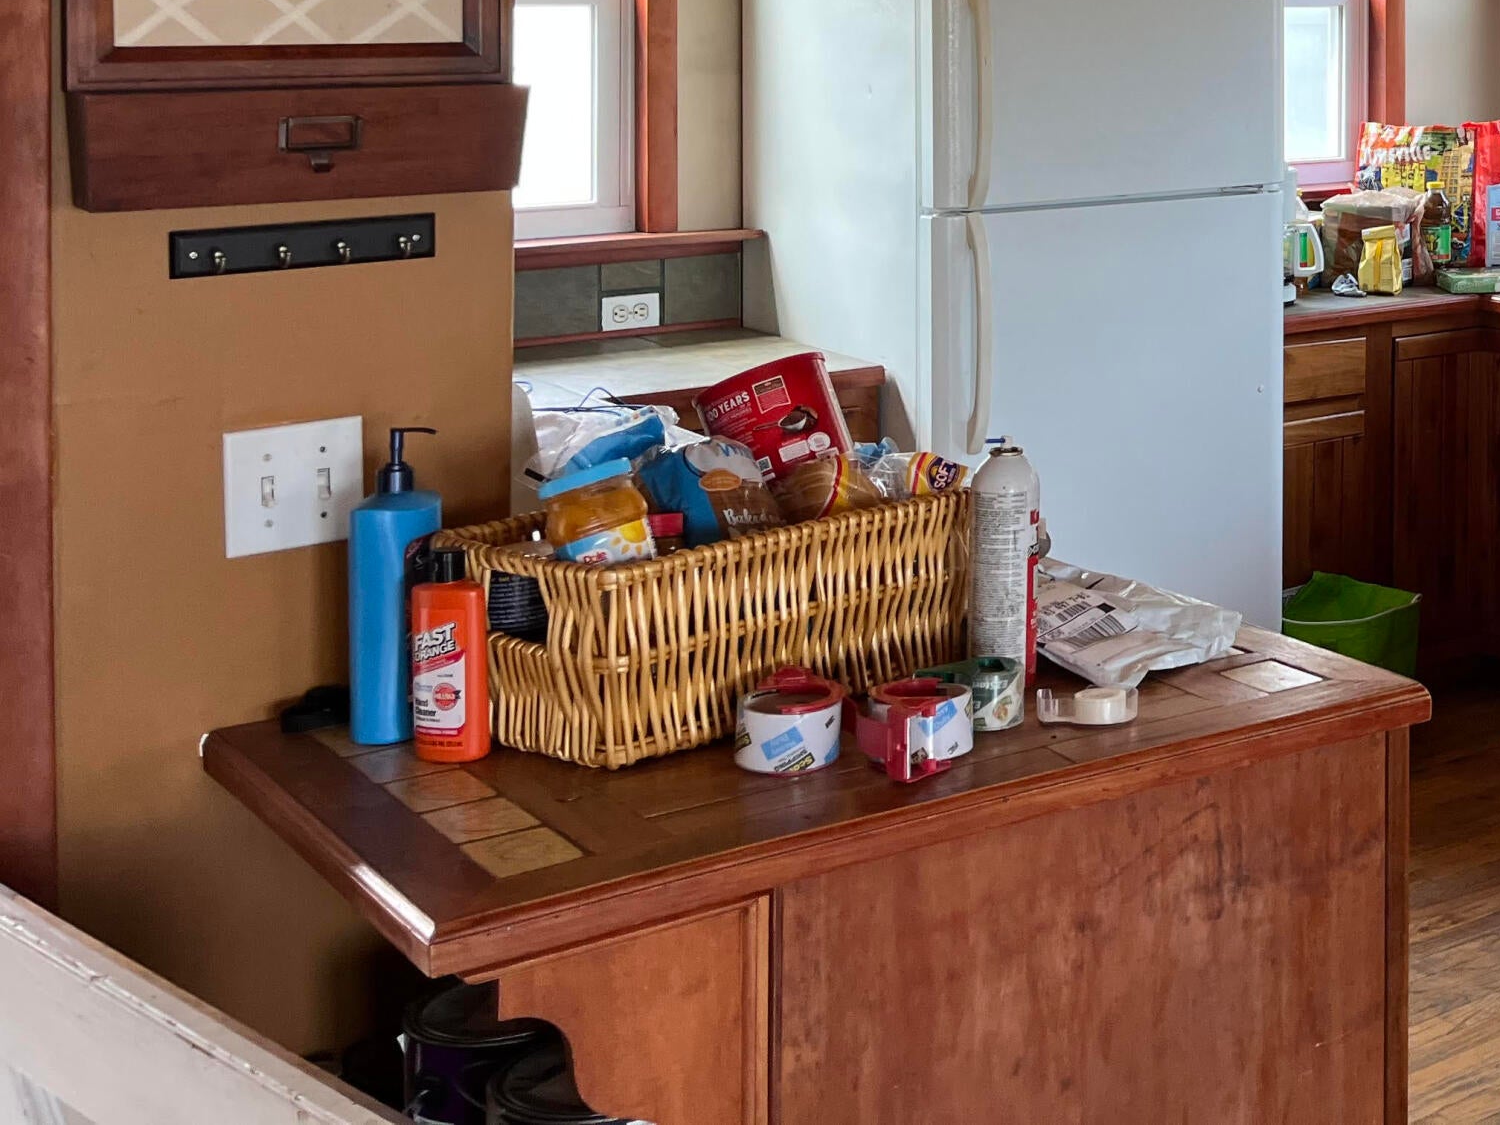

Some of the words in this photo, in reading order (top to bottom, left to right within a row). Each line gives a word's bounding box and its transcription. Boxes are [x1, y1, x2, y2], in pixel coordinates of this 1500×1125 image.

[718, 391, 750, 415] YEARS
[933, 459, 954, 489] SOFT
[415, 622, 457, 651] FAST
[414, 640, 456, 663] ORANGE
